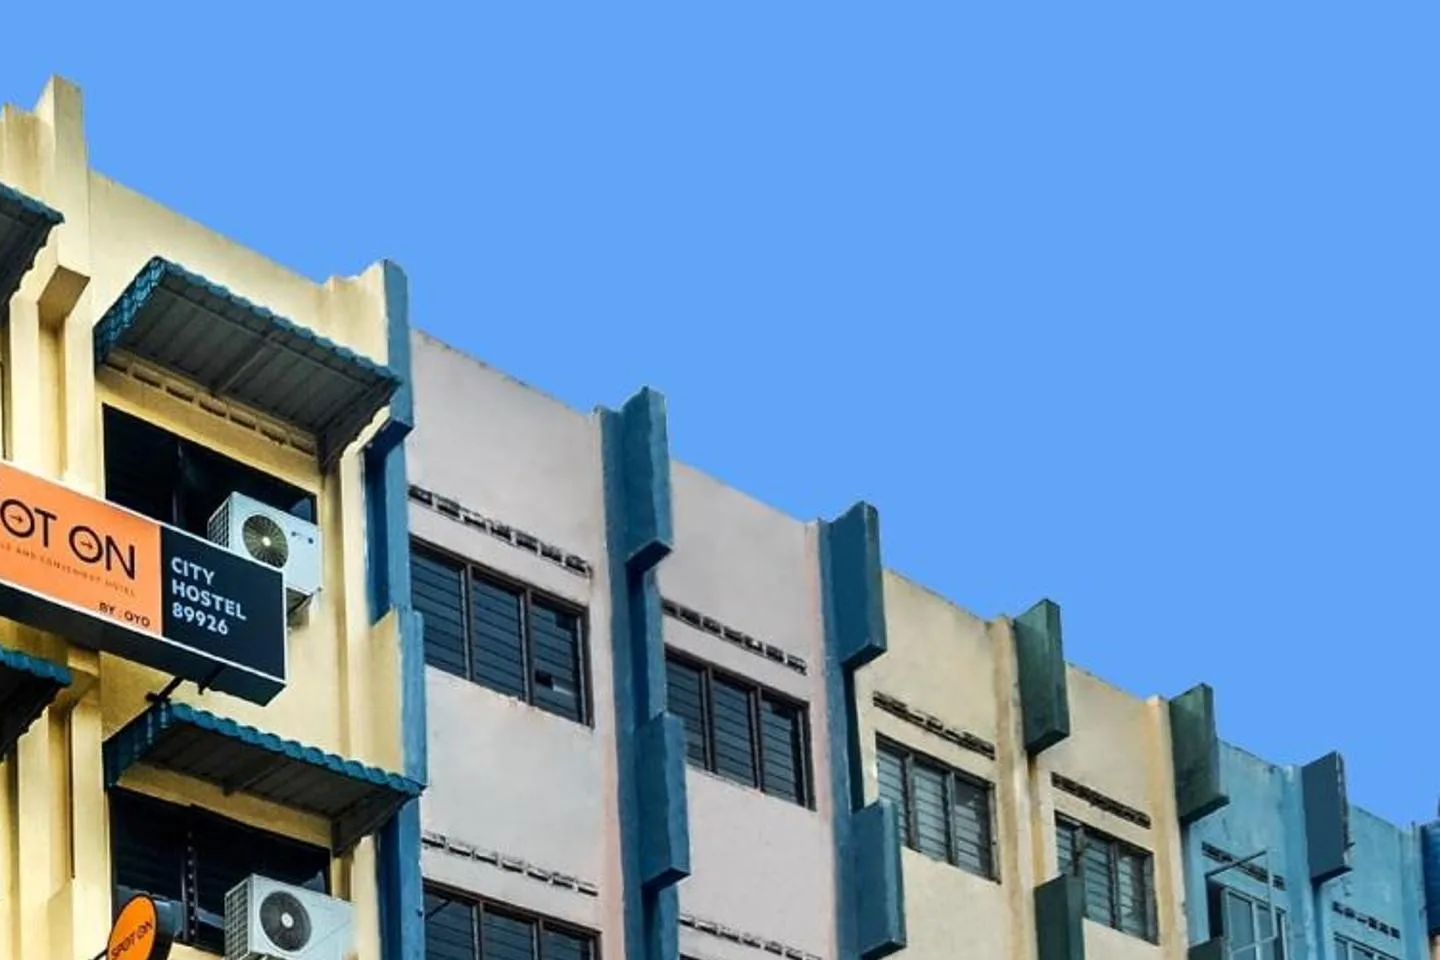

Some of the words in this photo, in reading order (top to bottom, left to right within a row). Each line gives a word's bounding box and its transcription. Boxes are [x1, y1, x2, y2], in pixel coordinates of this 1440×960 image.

[68, 525, 136, 580] ON
[171, 556, 216, 586] CITY
[171, 581, 248, 621] HOSTEL
[171, 602, 229, 636] 89926
